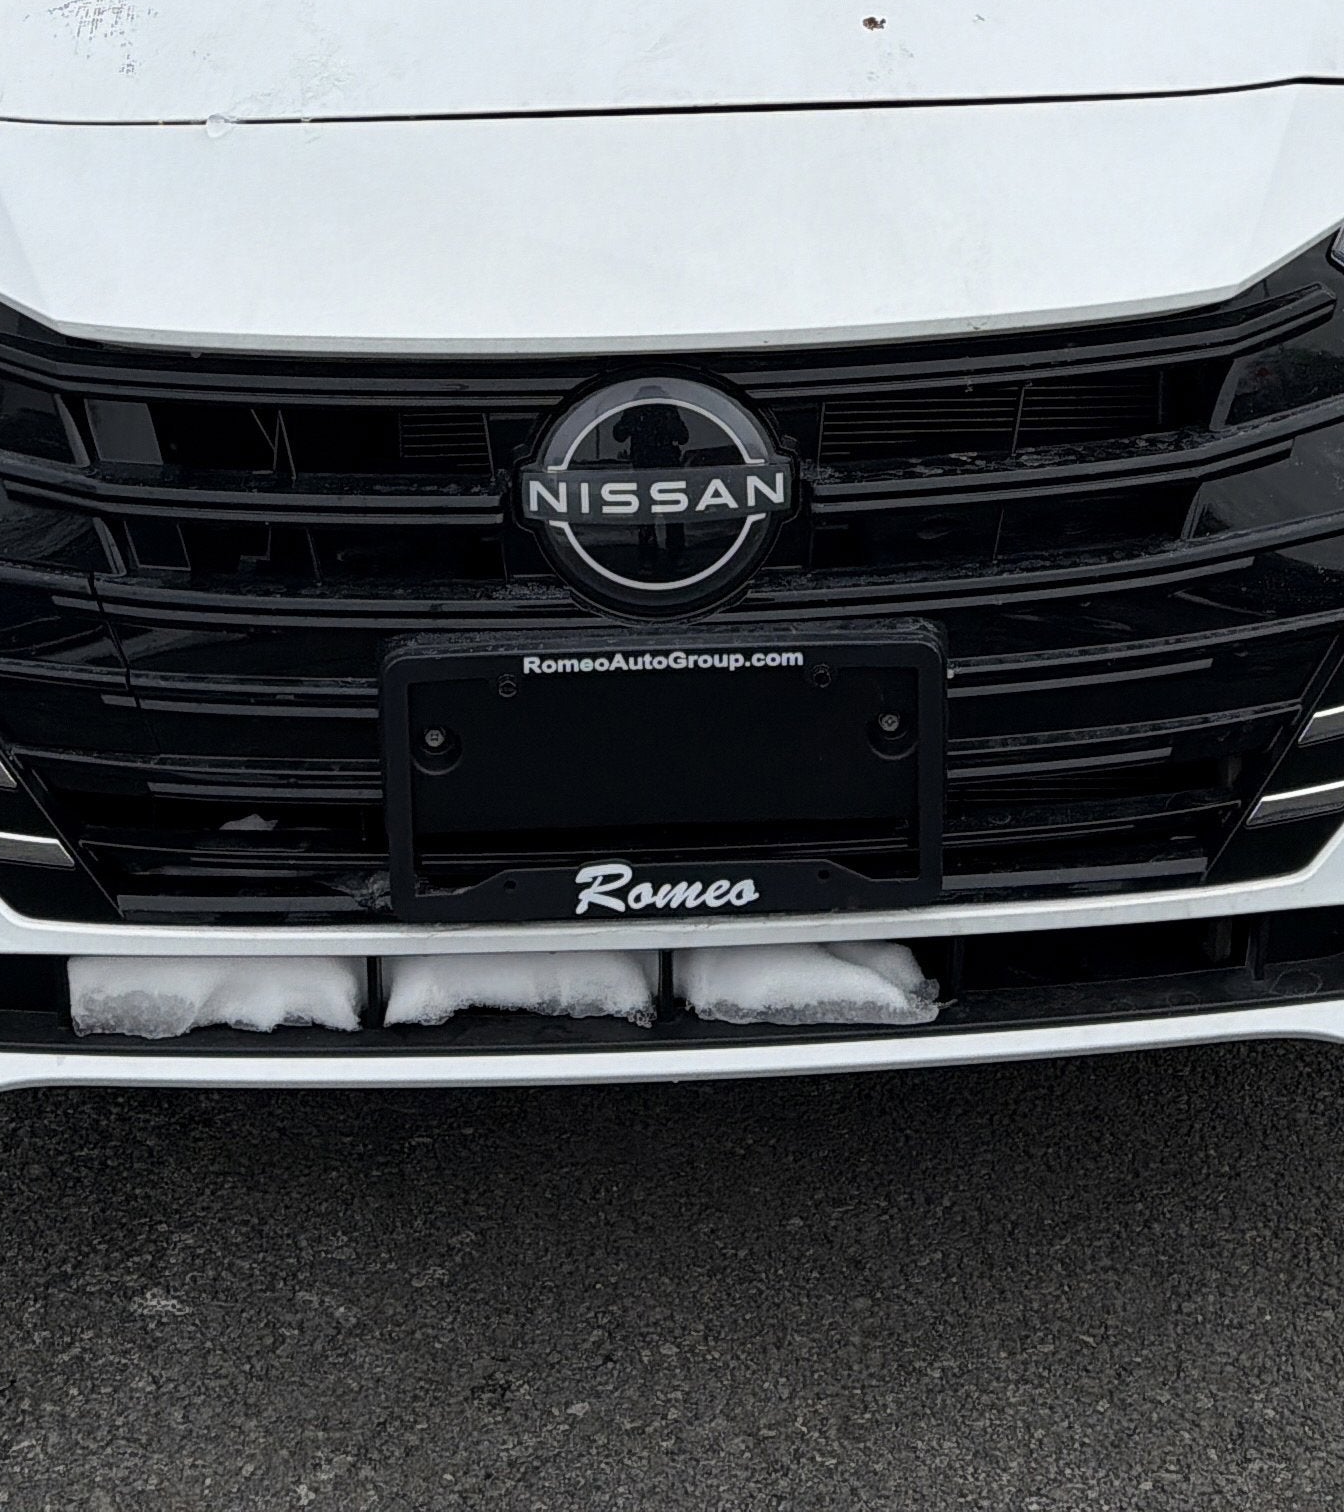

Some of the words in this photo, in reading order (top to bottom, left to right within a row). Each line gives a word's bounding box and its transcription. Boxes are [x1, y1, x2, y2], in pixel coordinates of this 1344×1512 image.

[529, 472, 786, 514] NISSAN
[522, 651, 804, 674] RomeoAutoGroup.com
[574, 863, 760, 915] Romeo
